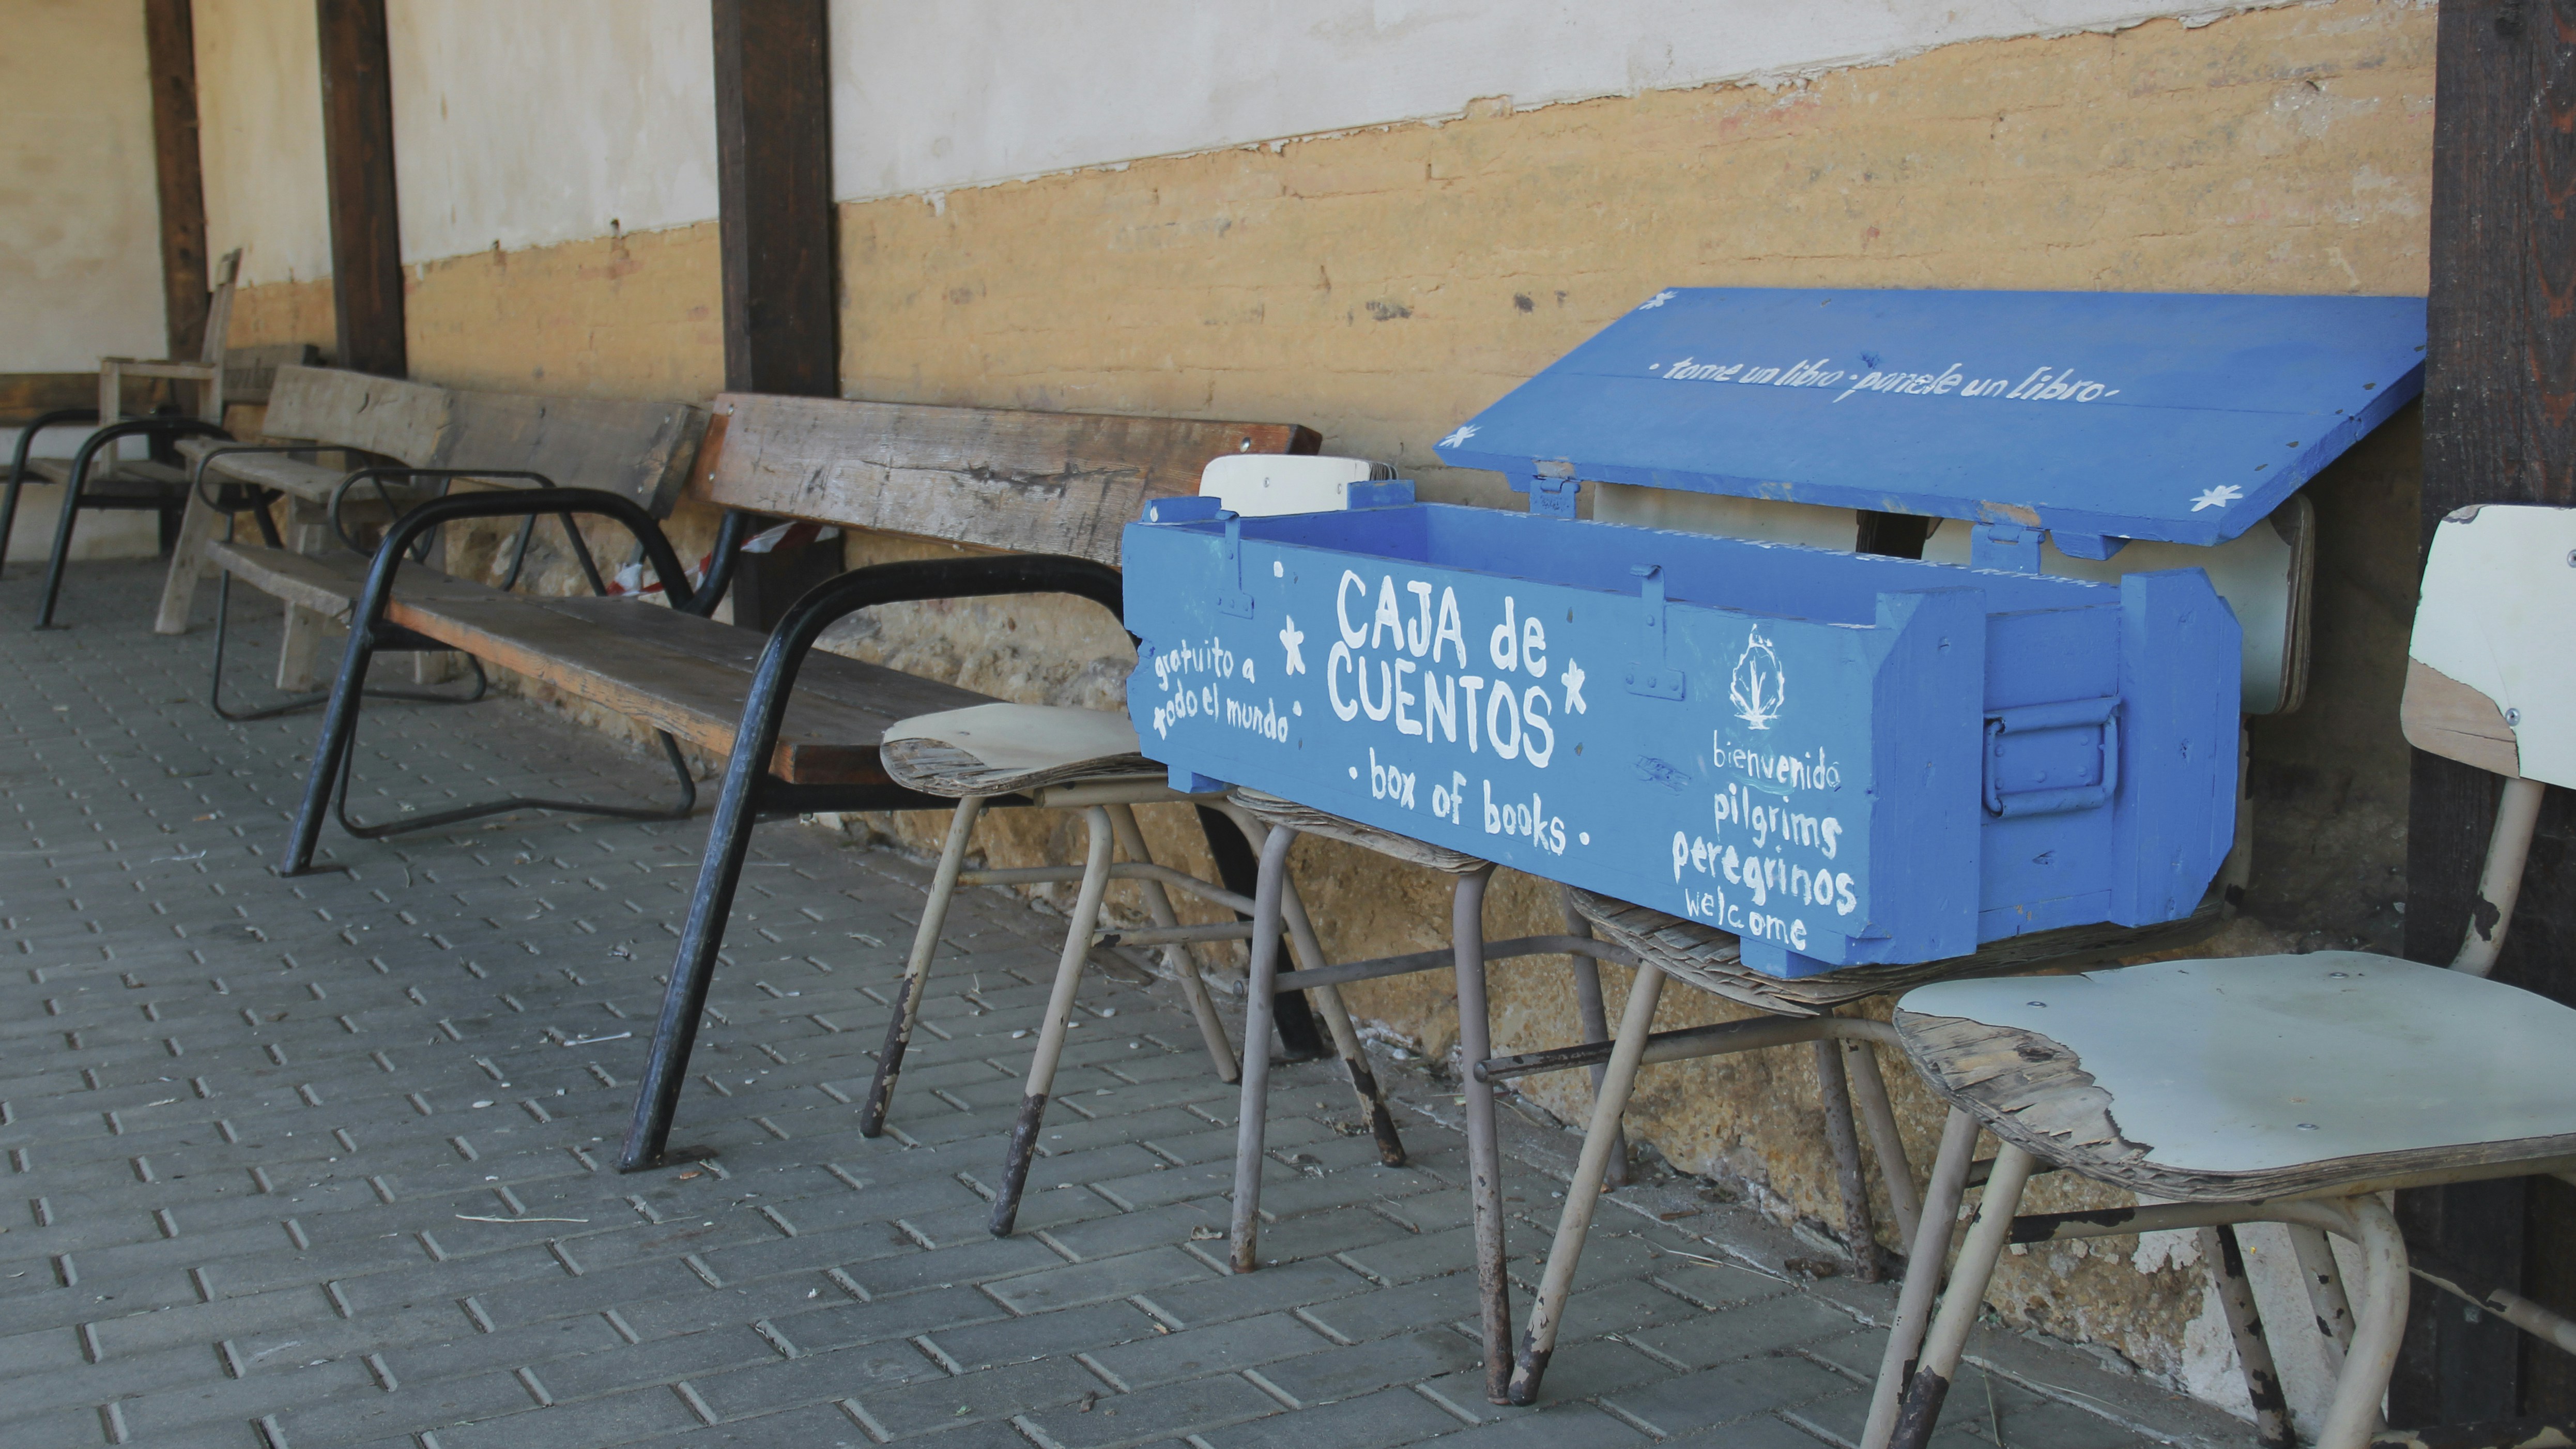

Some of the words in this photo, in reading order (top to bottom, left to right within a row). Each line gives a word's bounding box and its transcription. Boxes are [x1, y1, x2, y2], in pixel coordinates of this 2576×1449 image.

[1663, 357, 1744, 382] tome
[1738, 366, 1780, 384] un
[1773, 359, 1844, 387] libro
[1960, 378, 2008, 397] un
[2006, 366, 2105, 403] libro
[1336, 569, 1467, 669] CAJA
[1490, 596, 1547, 678] de
[1155, 636, 1234, 691] gratuito
[1242, 658, 1255, 684] a
[1153, 678, 1198, 741] todo
[1202, 683, 1219, 723] el
[1226, 697, 1288, 743] mundo
[1327, 640, 1554, 768] CUENTOS
[1369, 747, 1415, 810] box
[1432, 770, 1467, 824] of
[1483, 779, 1566, 856] books
[1714, 782, 1843, 859] pilgrims
[1672, 831, 1856, 916] peregrinos
[1685, 885, 1807, 950] welcome
